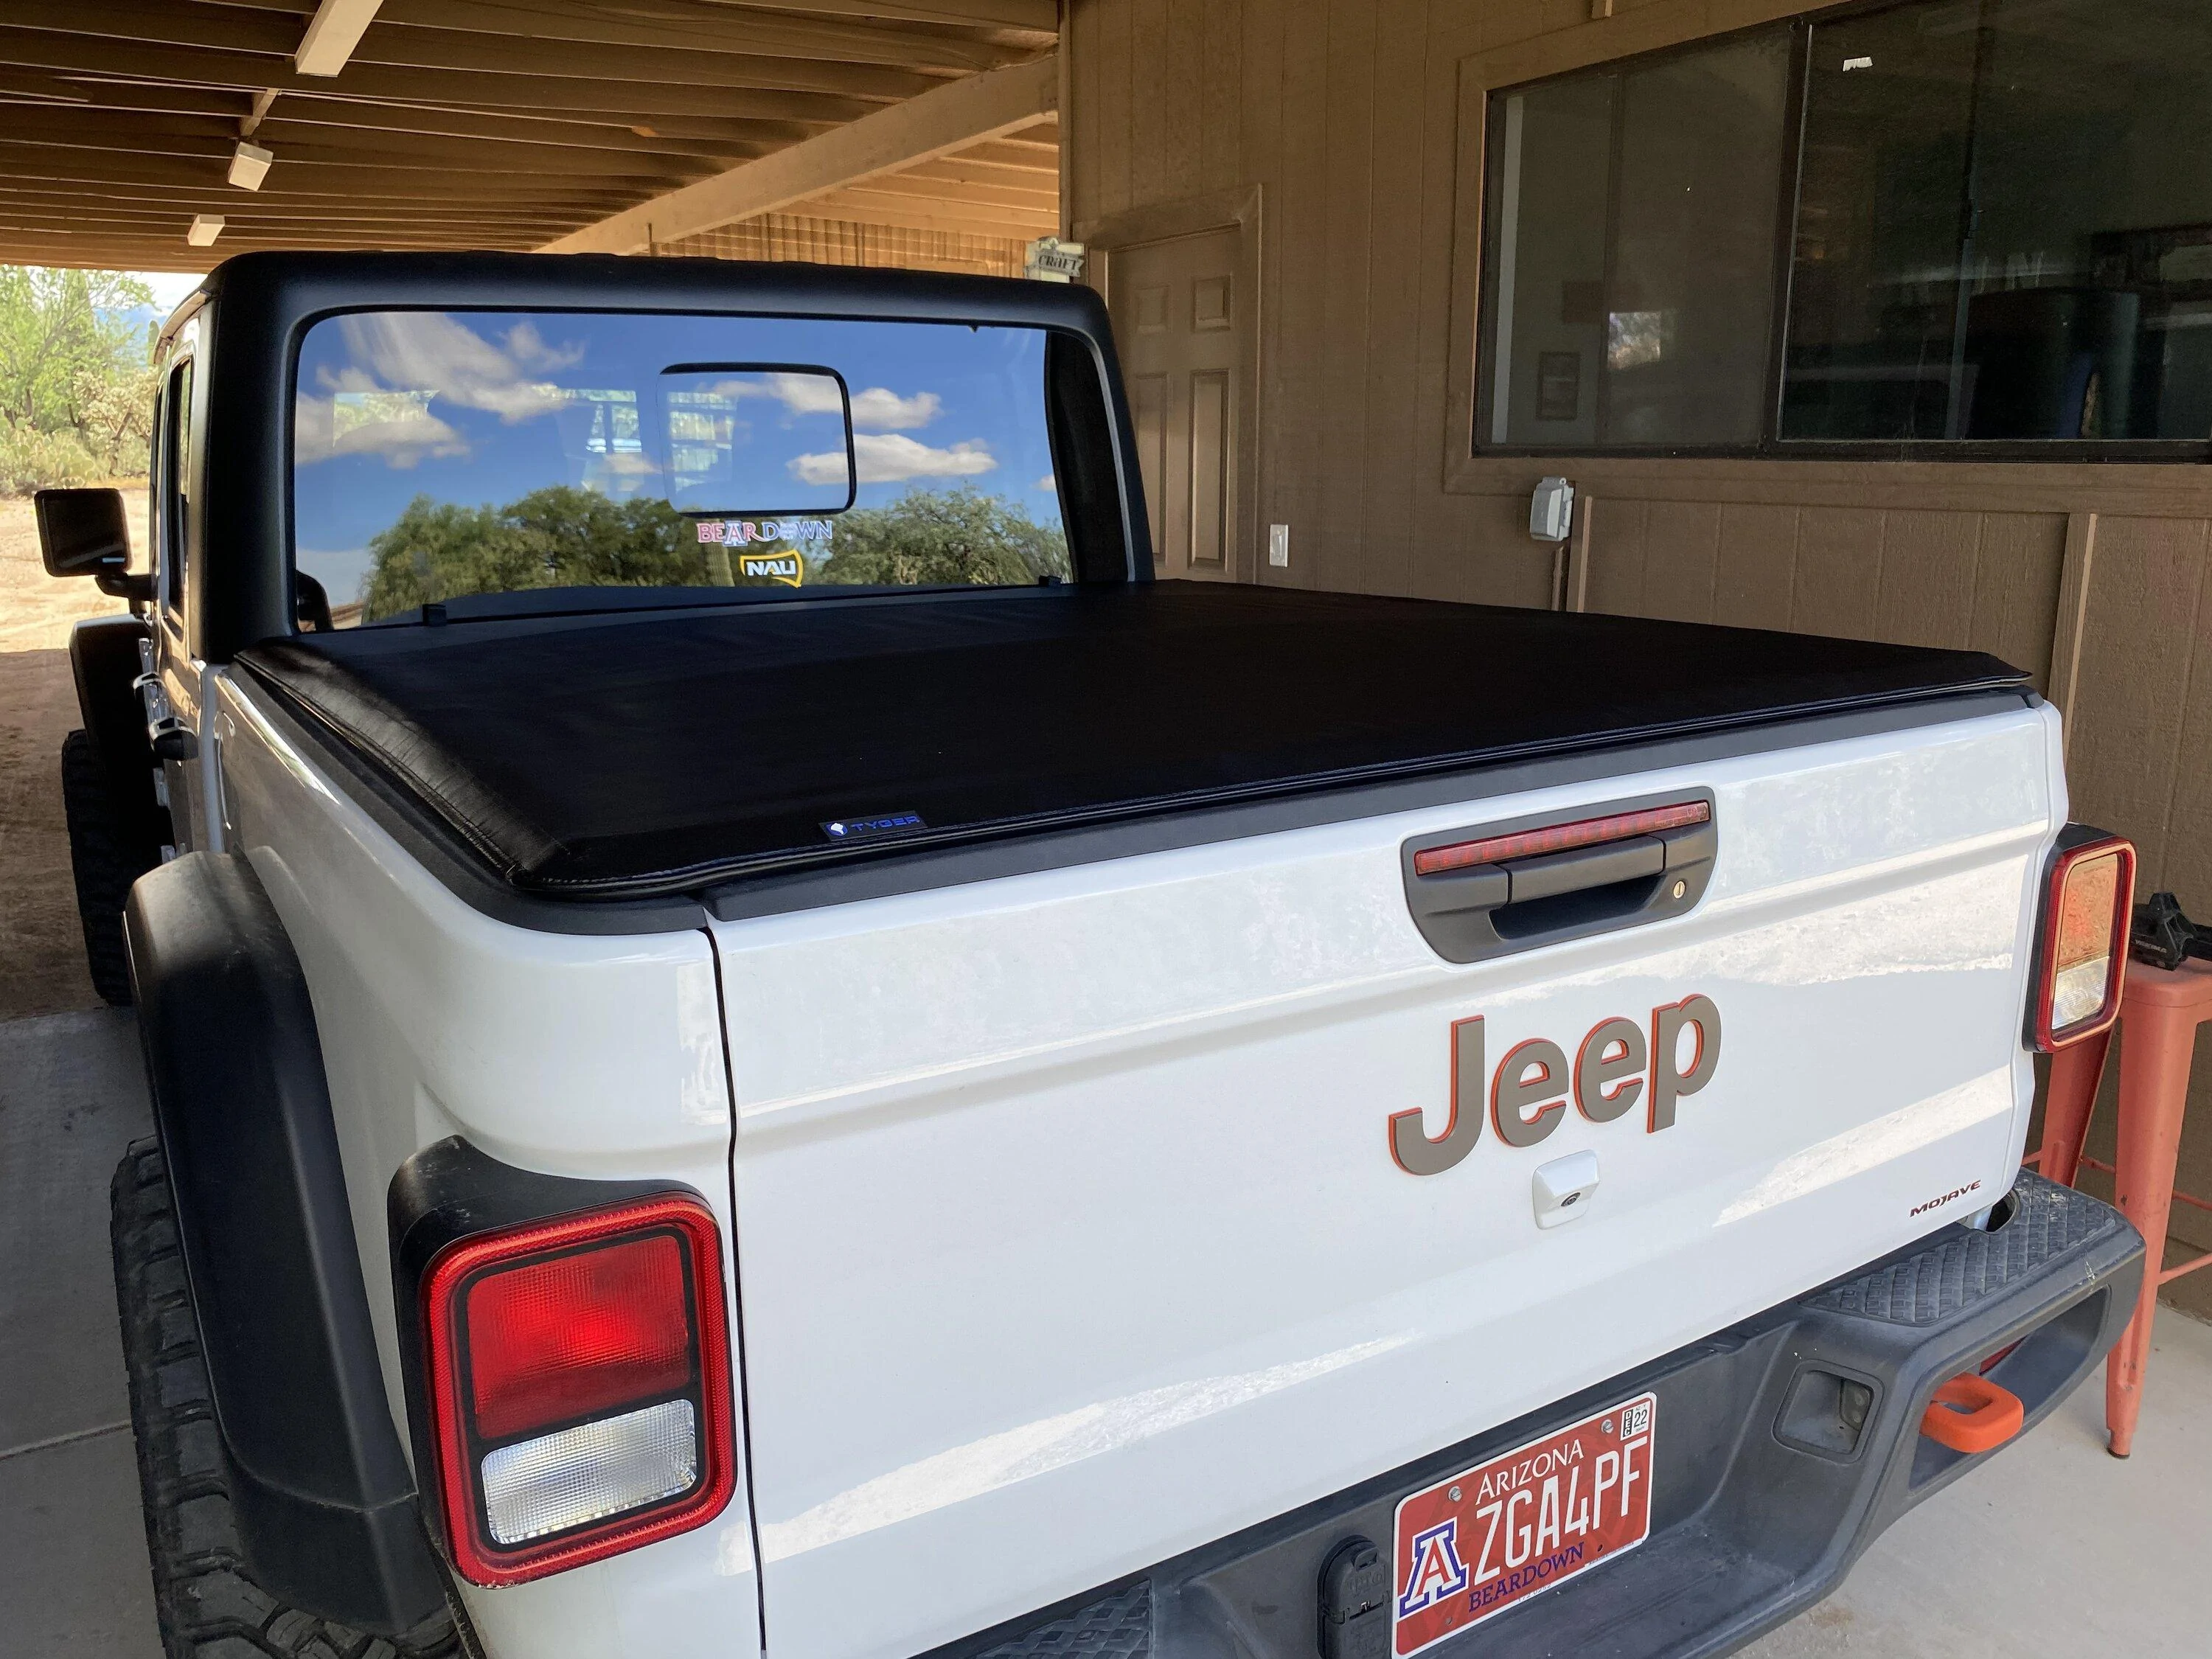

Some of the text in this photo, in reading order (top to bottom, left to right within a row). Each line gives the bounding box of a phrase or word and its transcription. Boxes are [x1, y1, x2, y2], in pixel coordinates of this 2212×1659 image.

[746, 560, 796, 576] NAU
[850, 815, 920, 832] TYGER
[1388, 993, 1722, 1176] Jeep
[1909, 1180, 1981, 1217] MOJAVE
[1634, 1410, 1647, 1427] 22
[1475, 1439, 1585, 1506] ARIZONA
[1474, 1436, 1648, 1586] ZGA4PF
